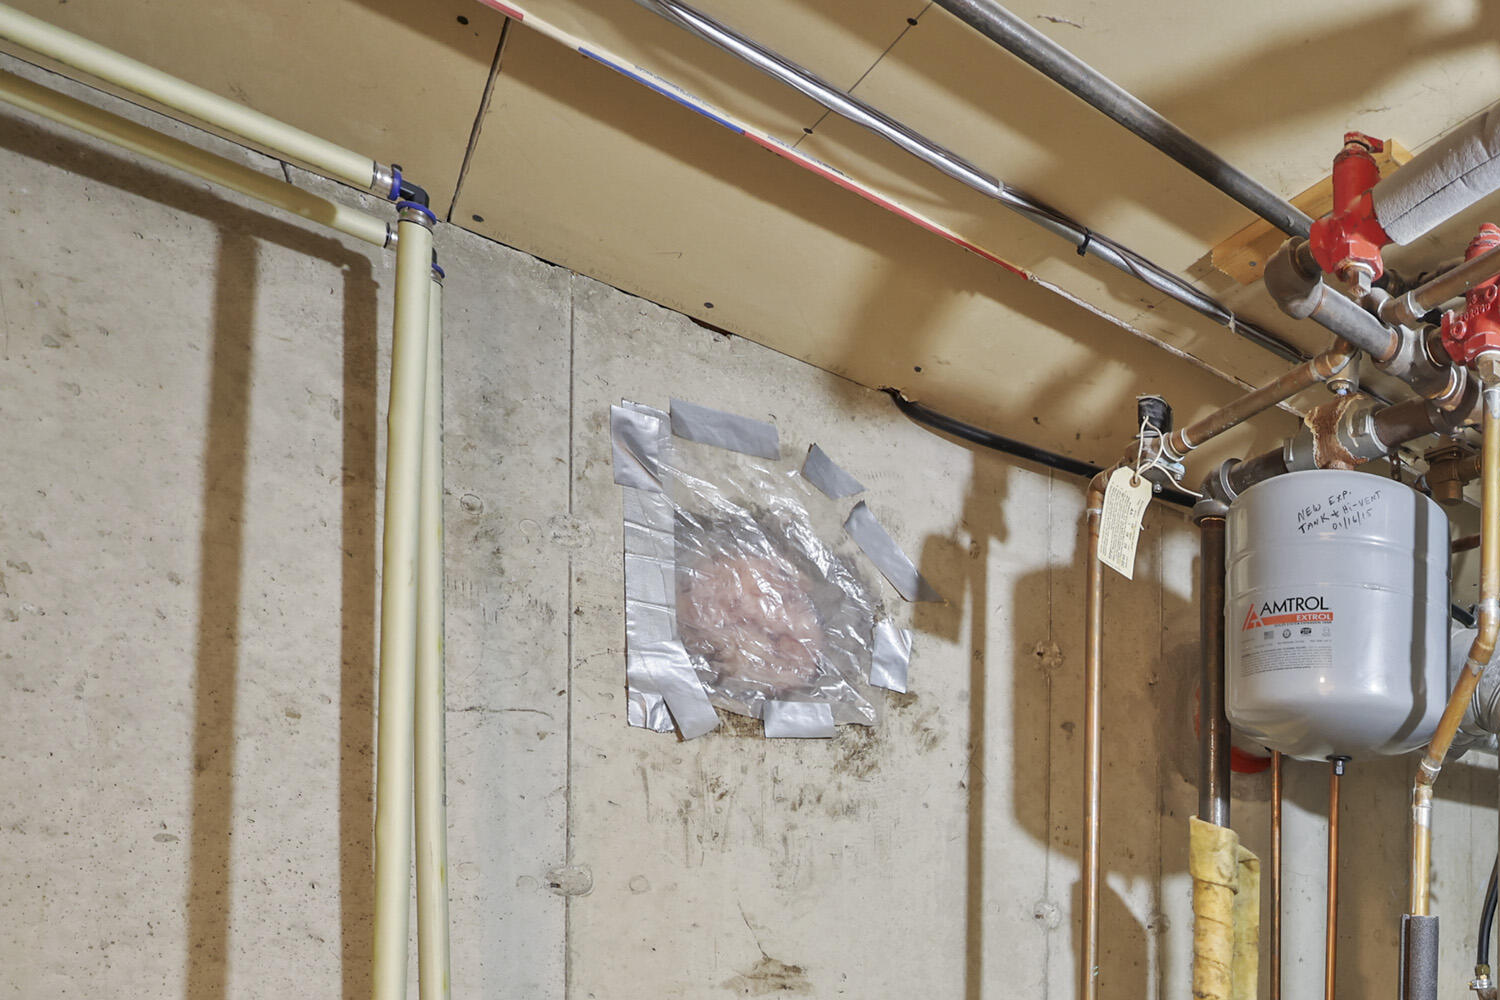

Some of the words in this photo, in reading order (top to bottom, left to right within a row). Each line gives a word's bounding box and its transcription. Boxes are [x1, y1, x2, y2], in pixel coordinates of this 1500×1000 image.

[1297, 503, 1321, 522] NEW
[1298, 513, 1330, 534] TANK
[1260, 596, 1329, 616] AMTROL
[1296, 613, 1331, 622] EXTROL
